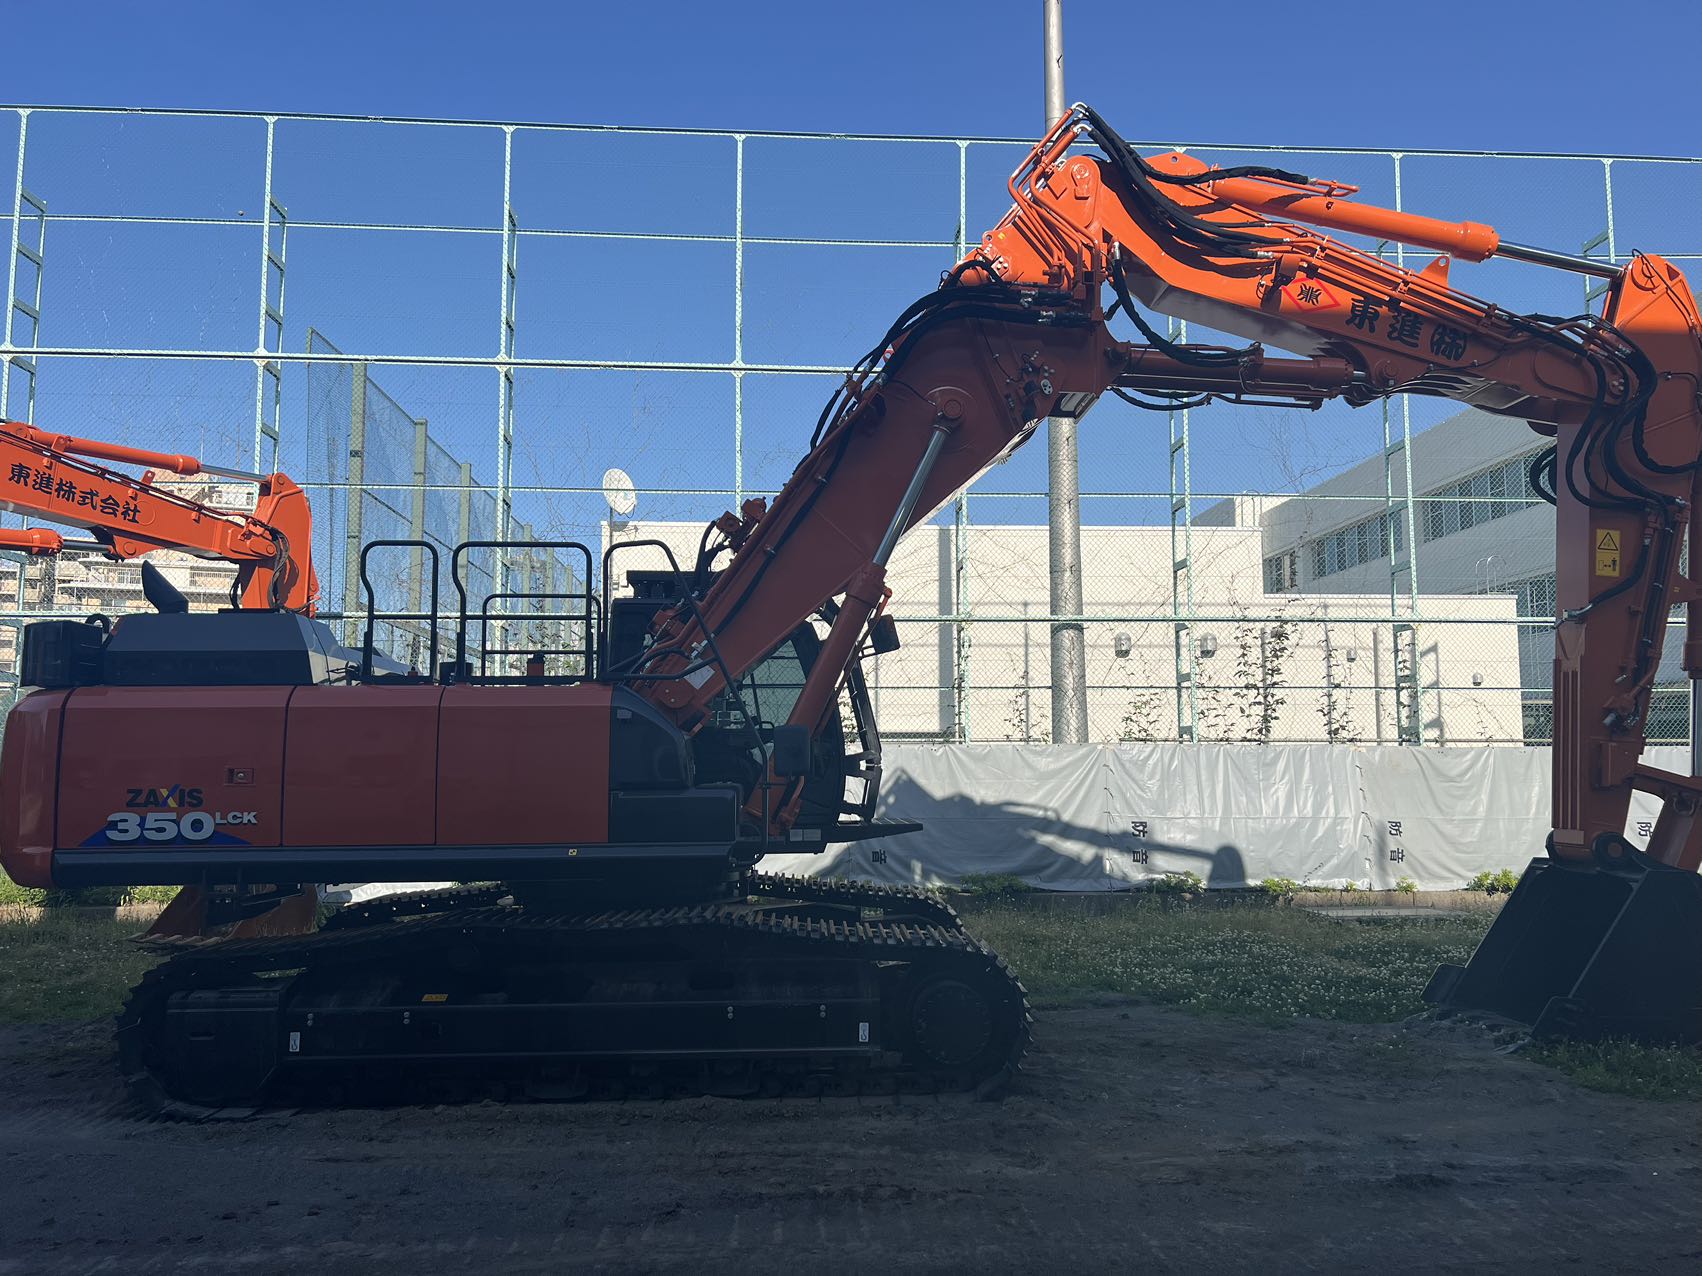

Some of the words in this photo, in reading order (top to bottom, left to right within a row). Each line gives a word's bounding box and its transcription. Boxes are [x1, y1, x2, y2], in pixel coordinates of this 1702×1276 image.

[8, 462, 142, 524] 東進株式会社
[126, 783, 204, 809] ZAXIS
[1131, 821, 1149, 865] 防音
[1388, 820, 1405, 864] 防音
